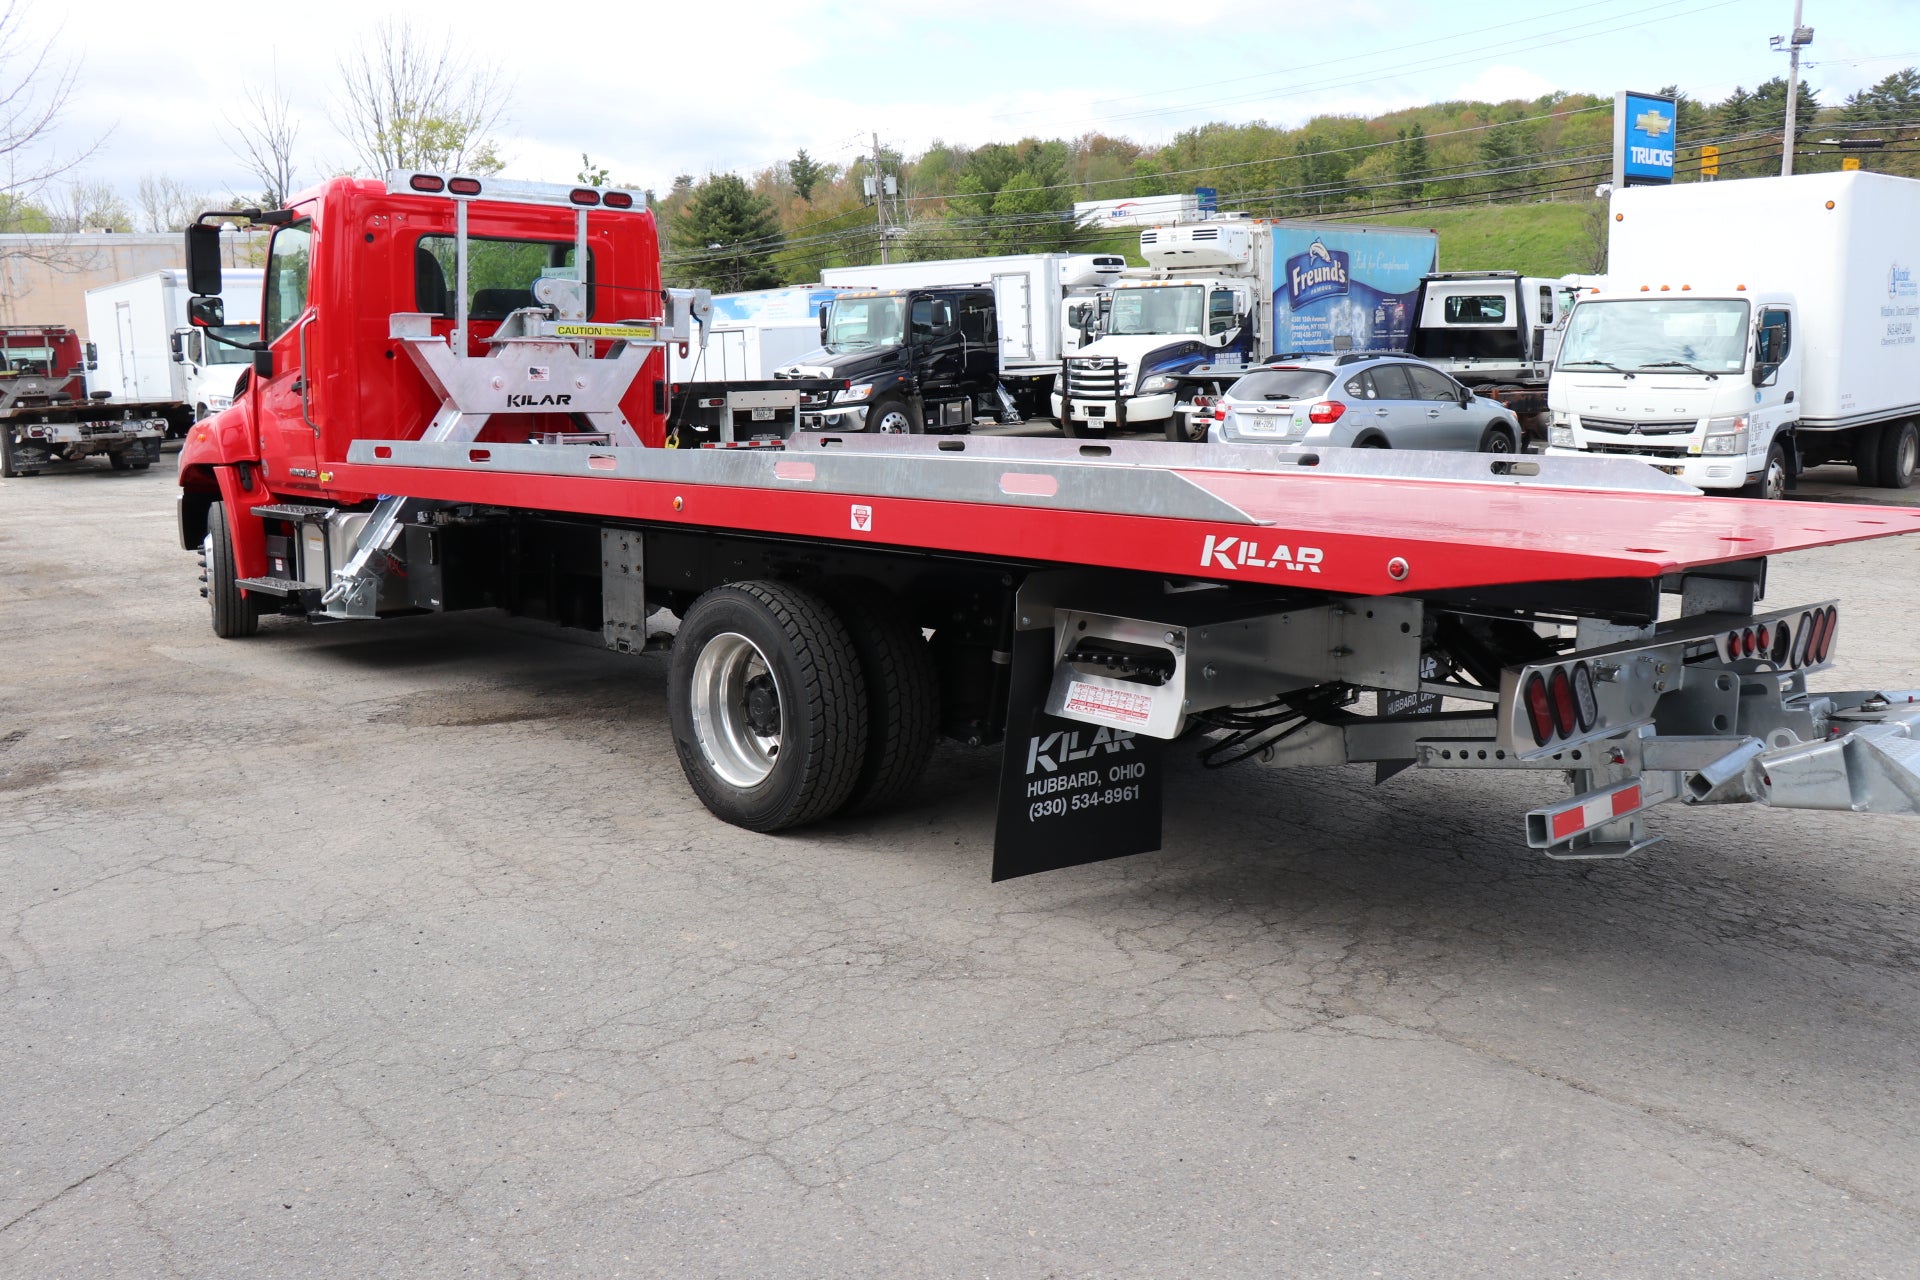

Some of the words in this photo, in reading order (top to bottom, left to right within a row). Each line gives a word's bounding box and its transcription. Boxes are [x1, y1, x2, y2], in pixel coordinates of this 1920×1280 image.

[1630, 146, 1673, 167] TRUCKS
[1292, 260, 1347, 297] Freund's
[1310, 284, 1332, 295] FAMOUS
[558, 326, 602, 335] CAUTION
[507, 394, 572, 408] KILAR
[1589, 404, 1686, 413] FUSO
[1200, 534, 1324, 573] KILAR
[1066, 703, 1096, 713] KILAR
[1388, 693, 1417, 716] HUBBARD,
[1026, 726, 1136, 775] KILAR
[1027, 770, 1102, 798] HUBBARD,
[1109, 762, 1146, 782] OHIO
[1029, 797, 1067, 822] (330)
[1071, 784, 1140, 811] 534-8961
